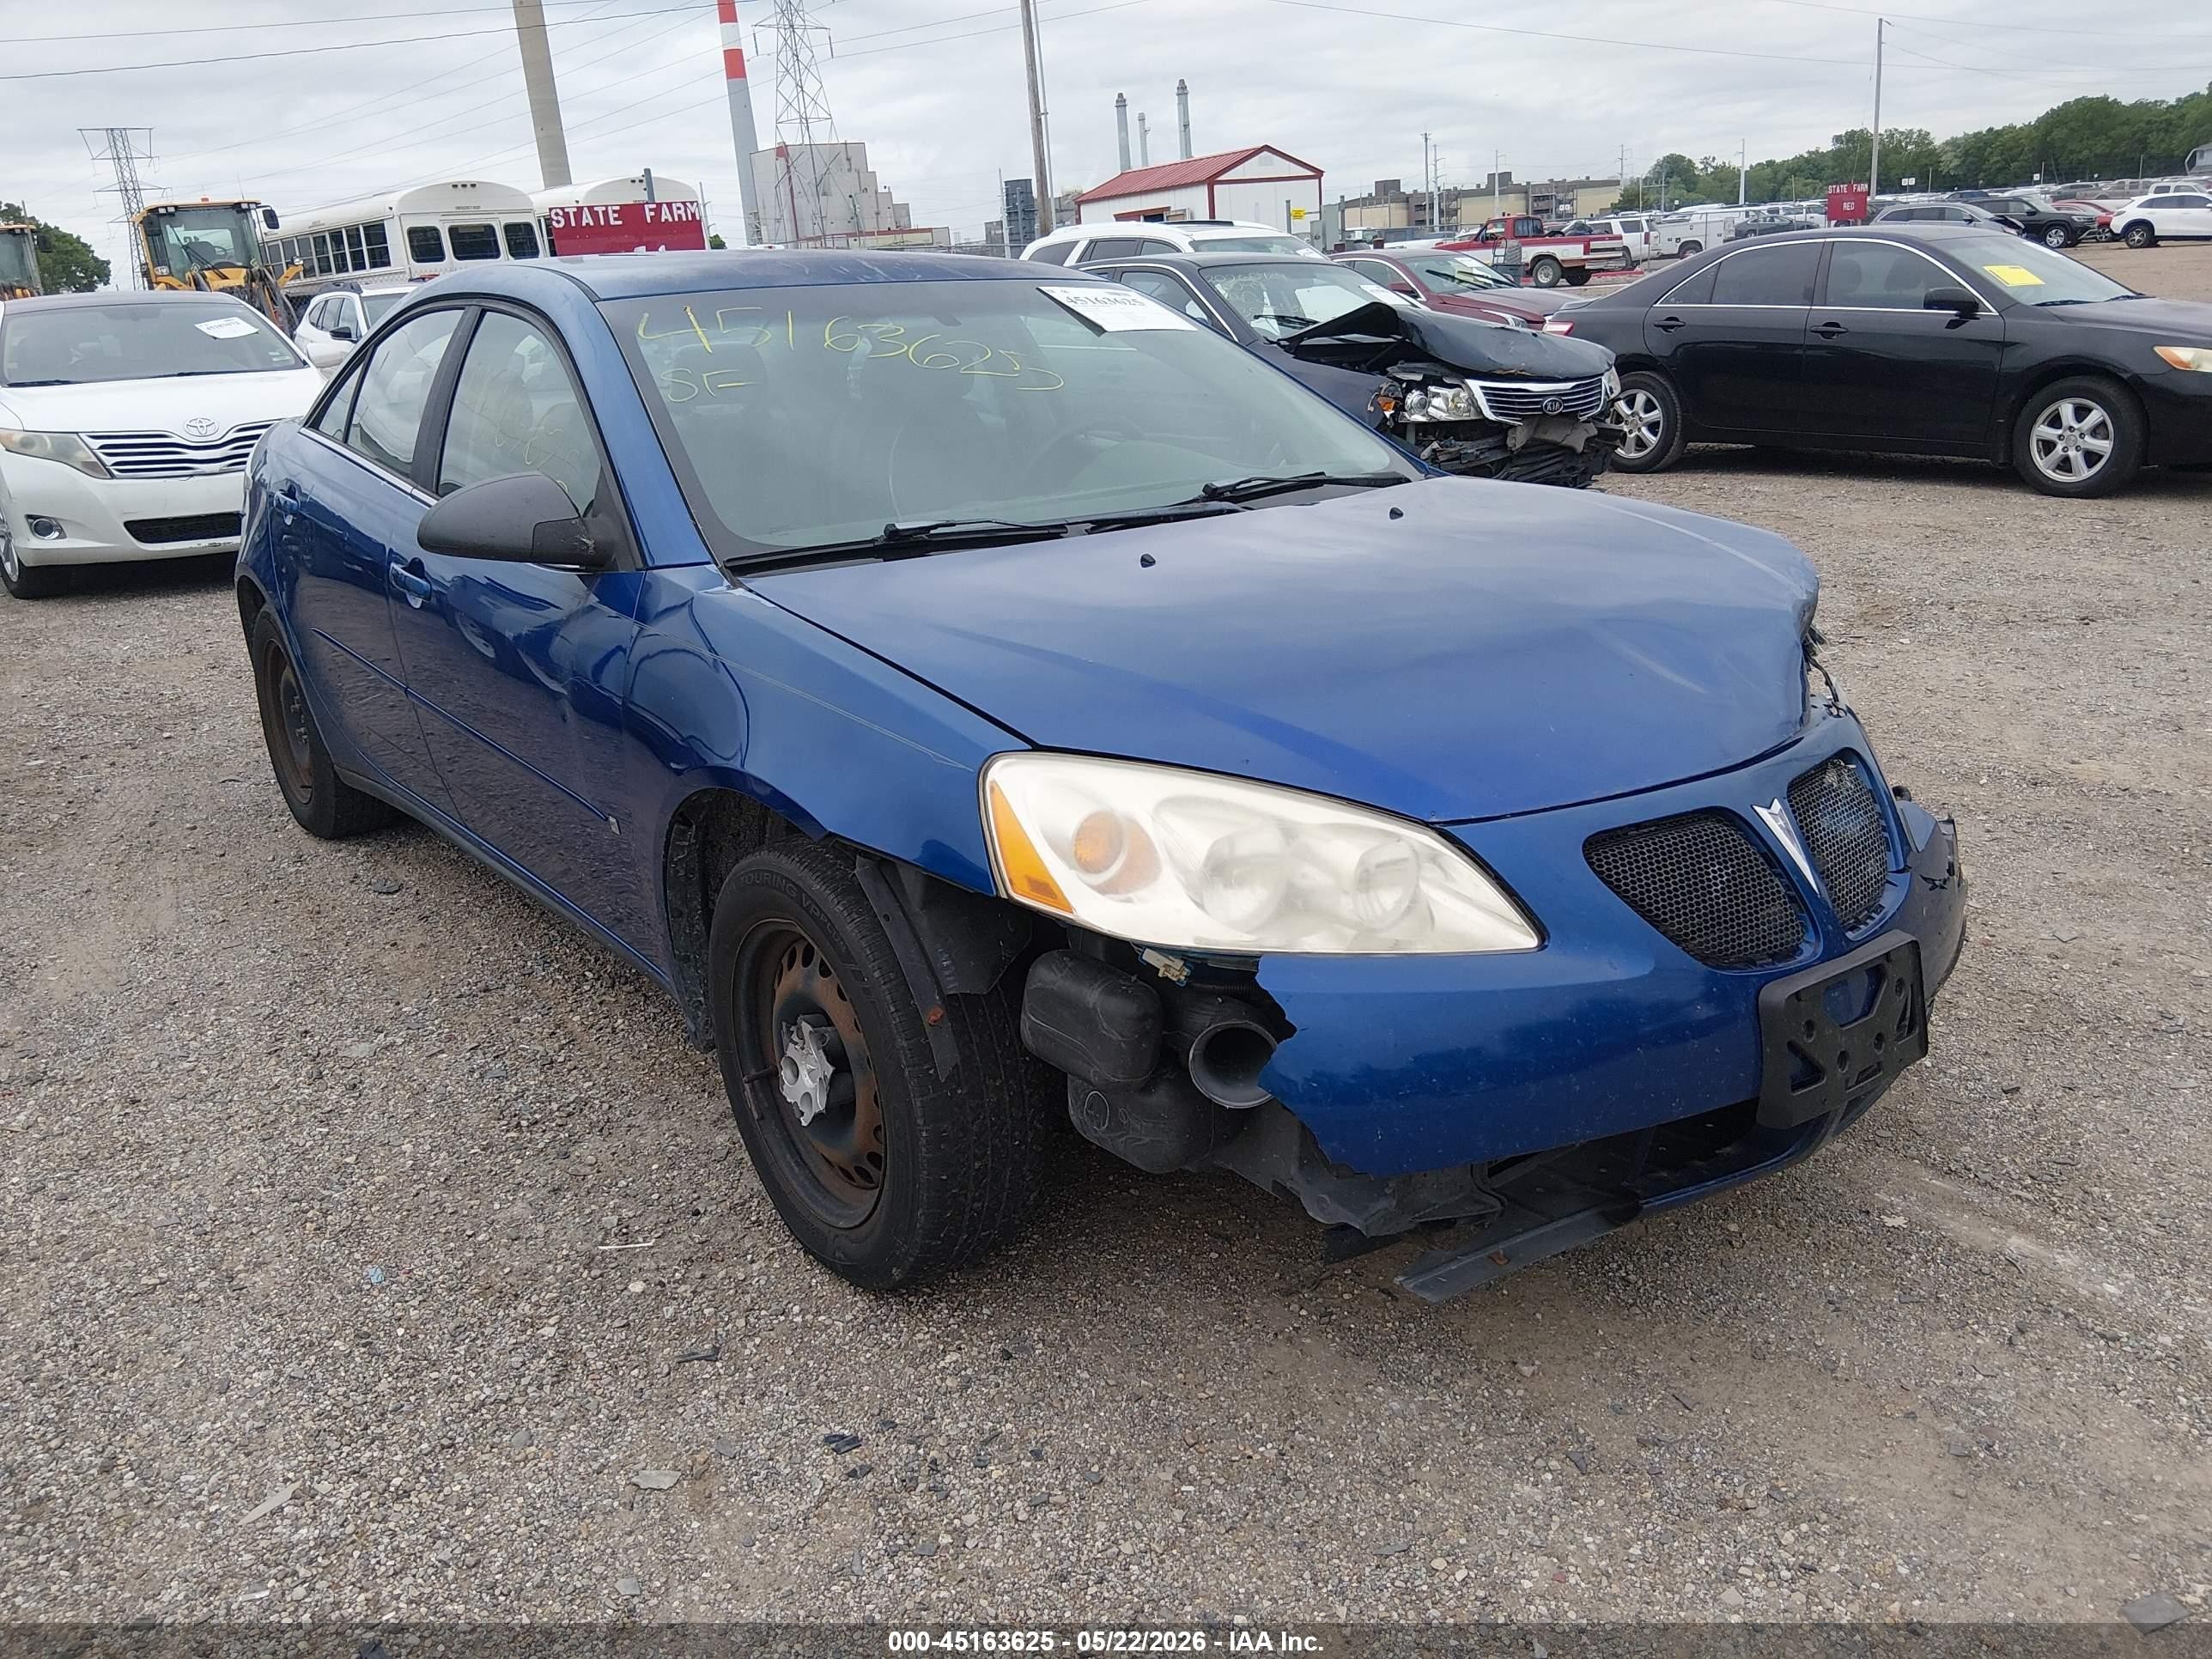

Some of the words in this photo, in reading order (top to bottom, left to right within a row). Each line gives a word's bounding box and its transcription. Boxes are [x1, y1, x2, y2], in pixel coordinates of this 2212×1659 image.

[1828, 185, 1848, 194] STATE
[1853, 184, 1869, 192] FARM
[550, 205, 623, 229] STATE
[645, 202, 701, 224] FARM
[1065, 295, 1146, 307] 45163625
[636, 305, 1065, 392] 45163625
